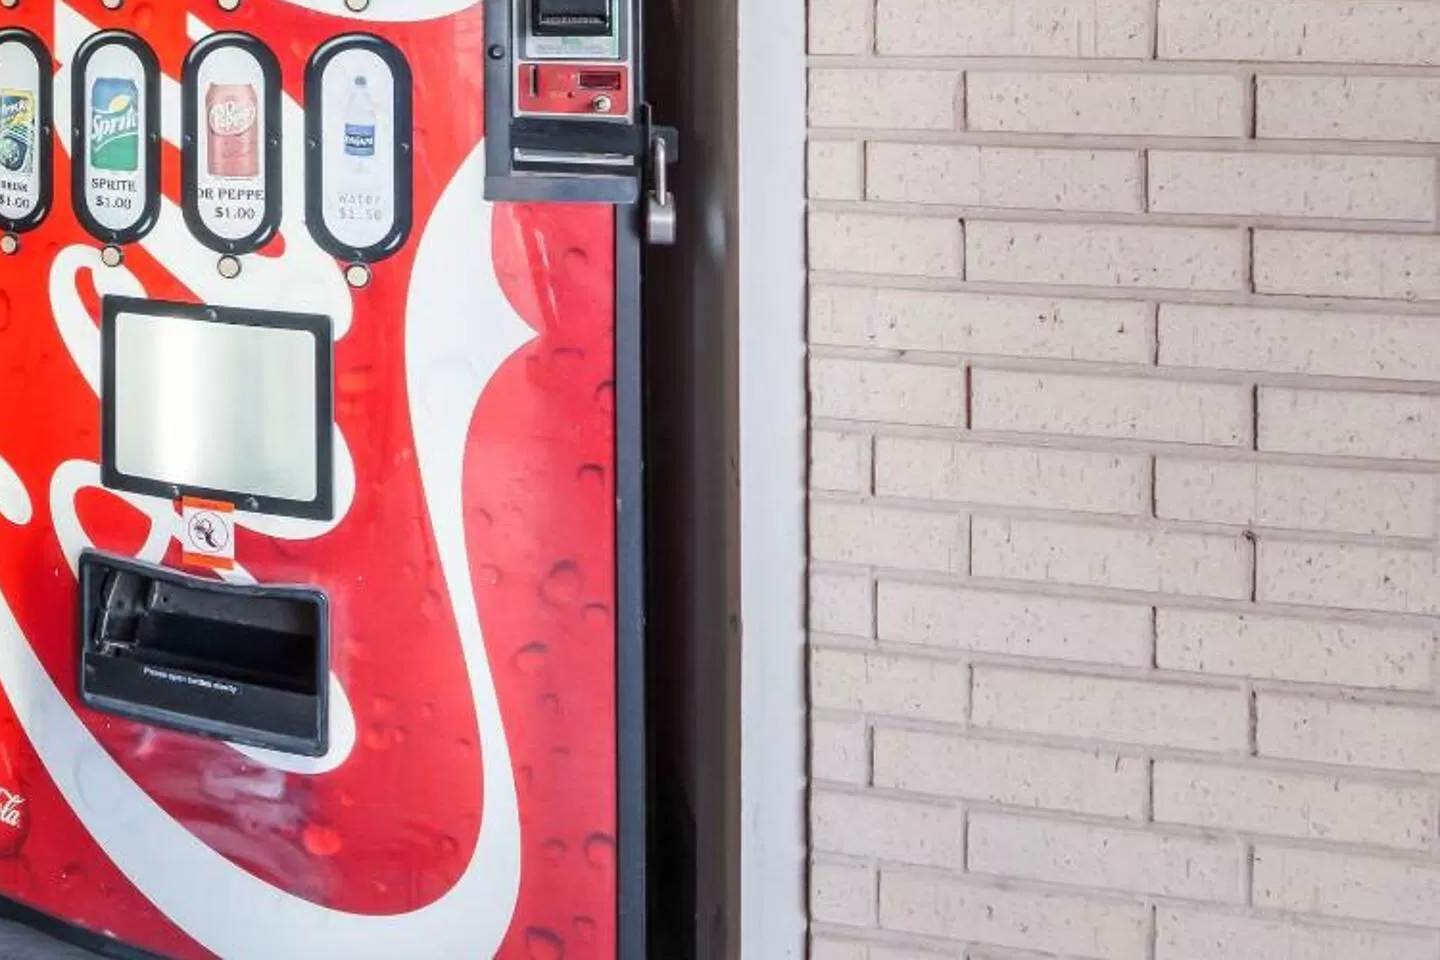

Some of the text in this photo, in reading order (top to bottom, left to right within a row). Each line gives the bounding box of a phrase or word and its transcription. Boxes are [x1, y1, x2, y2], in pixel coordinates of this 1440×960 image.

[92, 178, 137, 193] SPRITE
[96, 195, 132, 210] $1.00
[215, 206, 256, 220] $1.00
